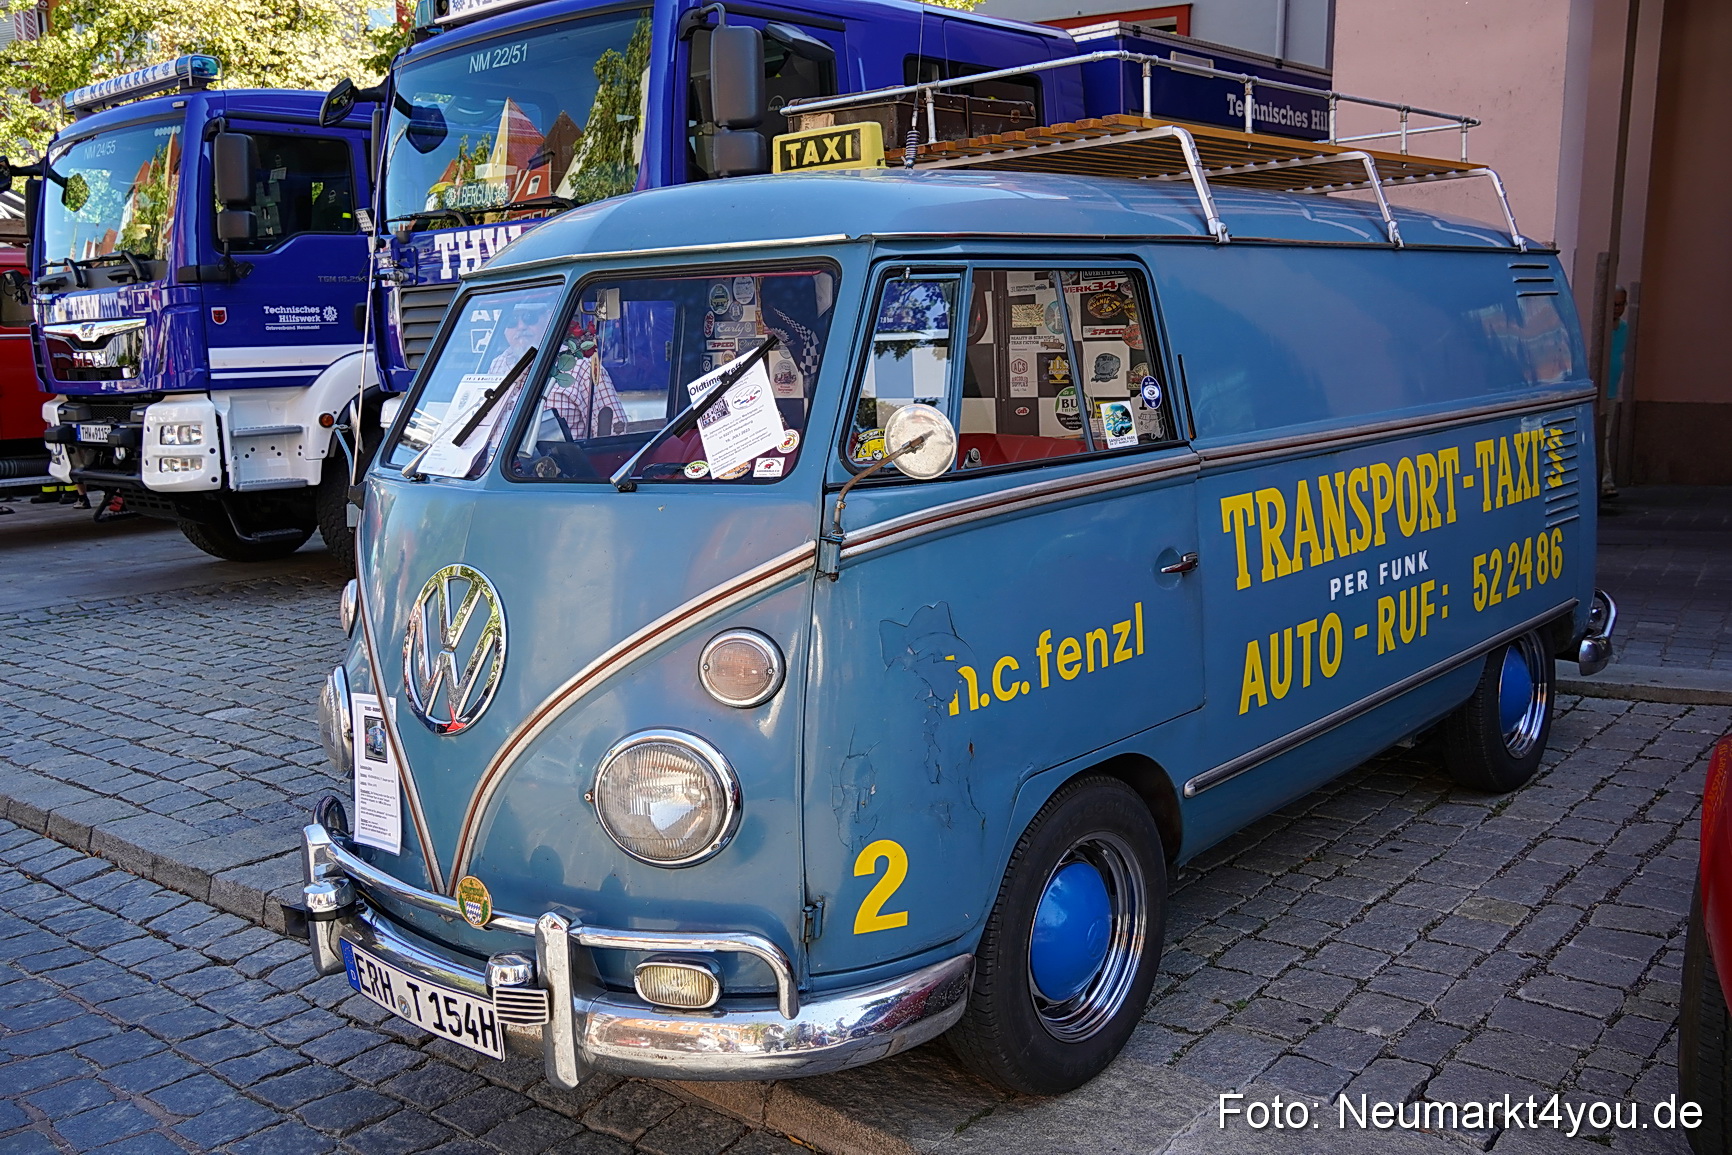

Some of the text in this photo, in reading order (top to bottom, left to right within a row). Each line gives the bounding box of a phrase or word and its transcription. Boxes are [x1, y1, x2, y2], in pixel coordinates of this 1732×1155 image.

[469, 42, 528, 74] NM 22/51
[89, 66, 159, 99] NEUMARKT
[1227, 93, 1309, 129] Tehnisches
[84, 143, 96, 161] NM
[786, 134, 853, 168] TAXI
[434, 225, 521, 280] THW
[263, 305, 321, 314] Technisches
[279, 314, 321, 323] Hilfswerk
[1013, 359, 1026, 372] ACS
[1330, 550, 1429, 601] PER FUNK
[853, 839, 909, 935] 2
[354, 953, 397, 1009] ERH
[406, 980, 423, 1023] T
[428, 991, 499, 1052] 154H
